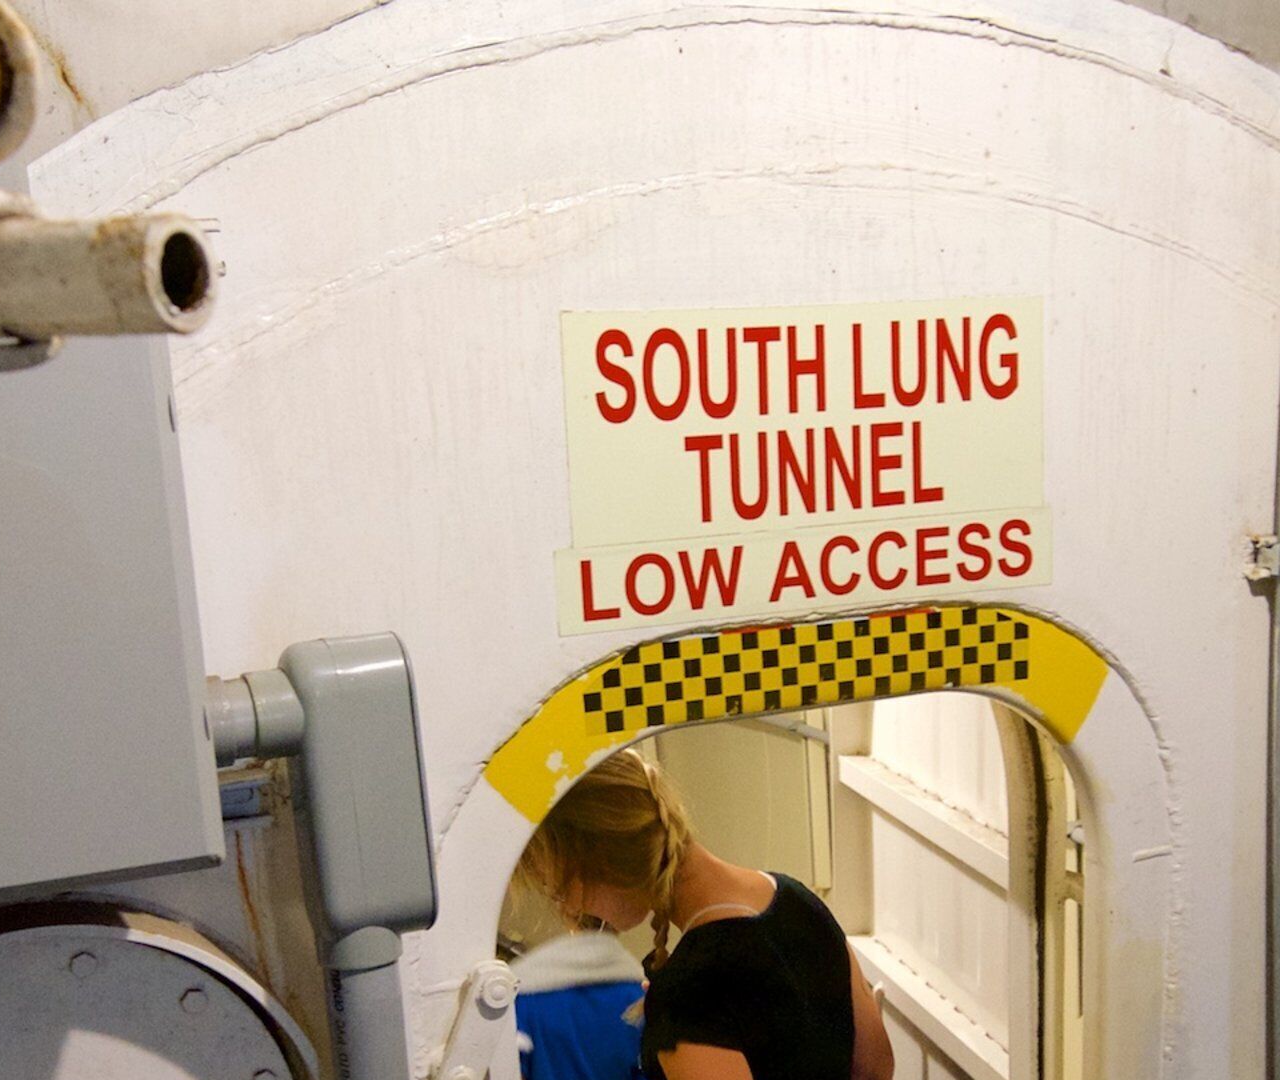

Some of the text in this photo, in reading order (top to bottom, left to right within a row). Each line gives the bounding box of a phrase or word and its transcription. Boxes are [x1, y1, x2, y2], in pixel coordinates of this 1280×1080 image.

[595, 313, 1018, 424] SOUTH LUNG
[684, 421, 944, 523] TUNNEL
[580, 519, 1033, 622] LOW ACCESS
